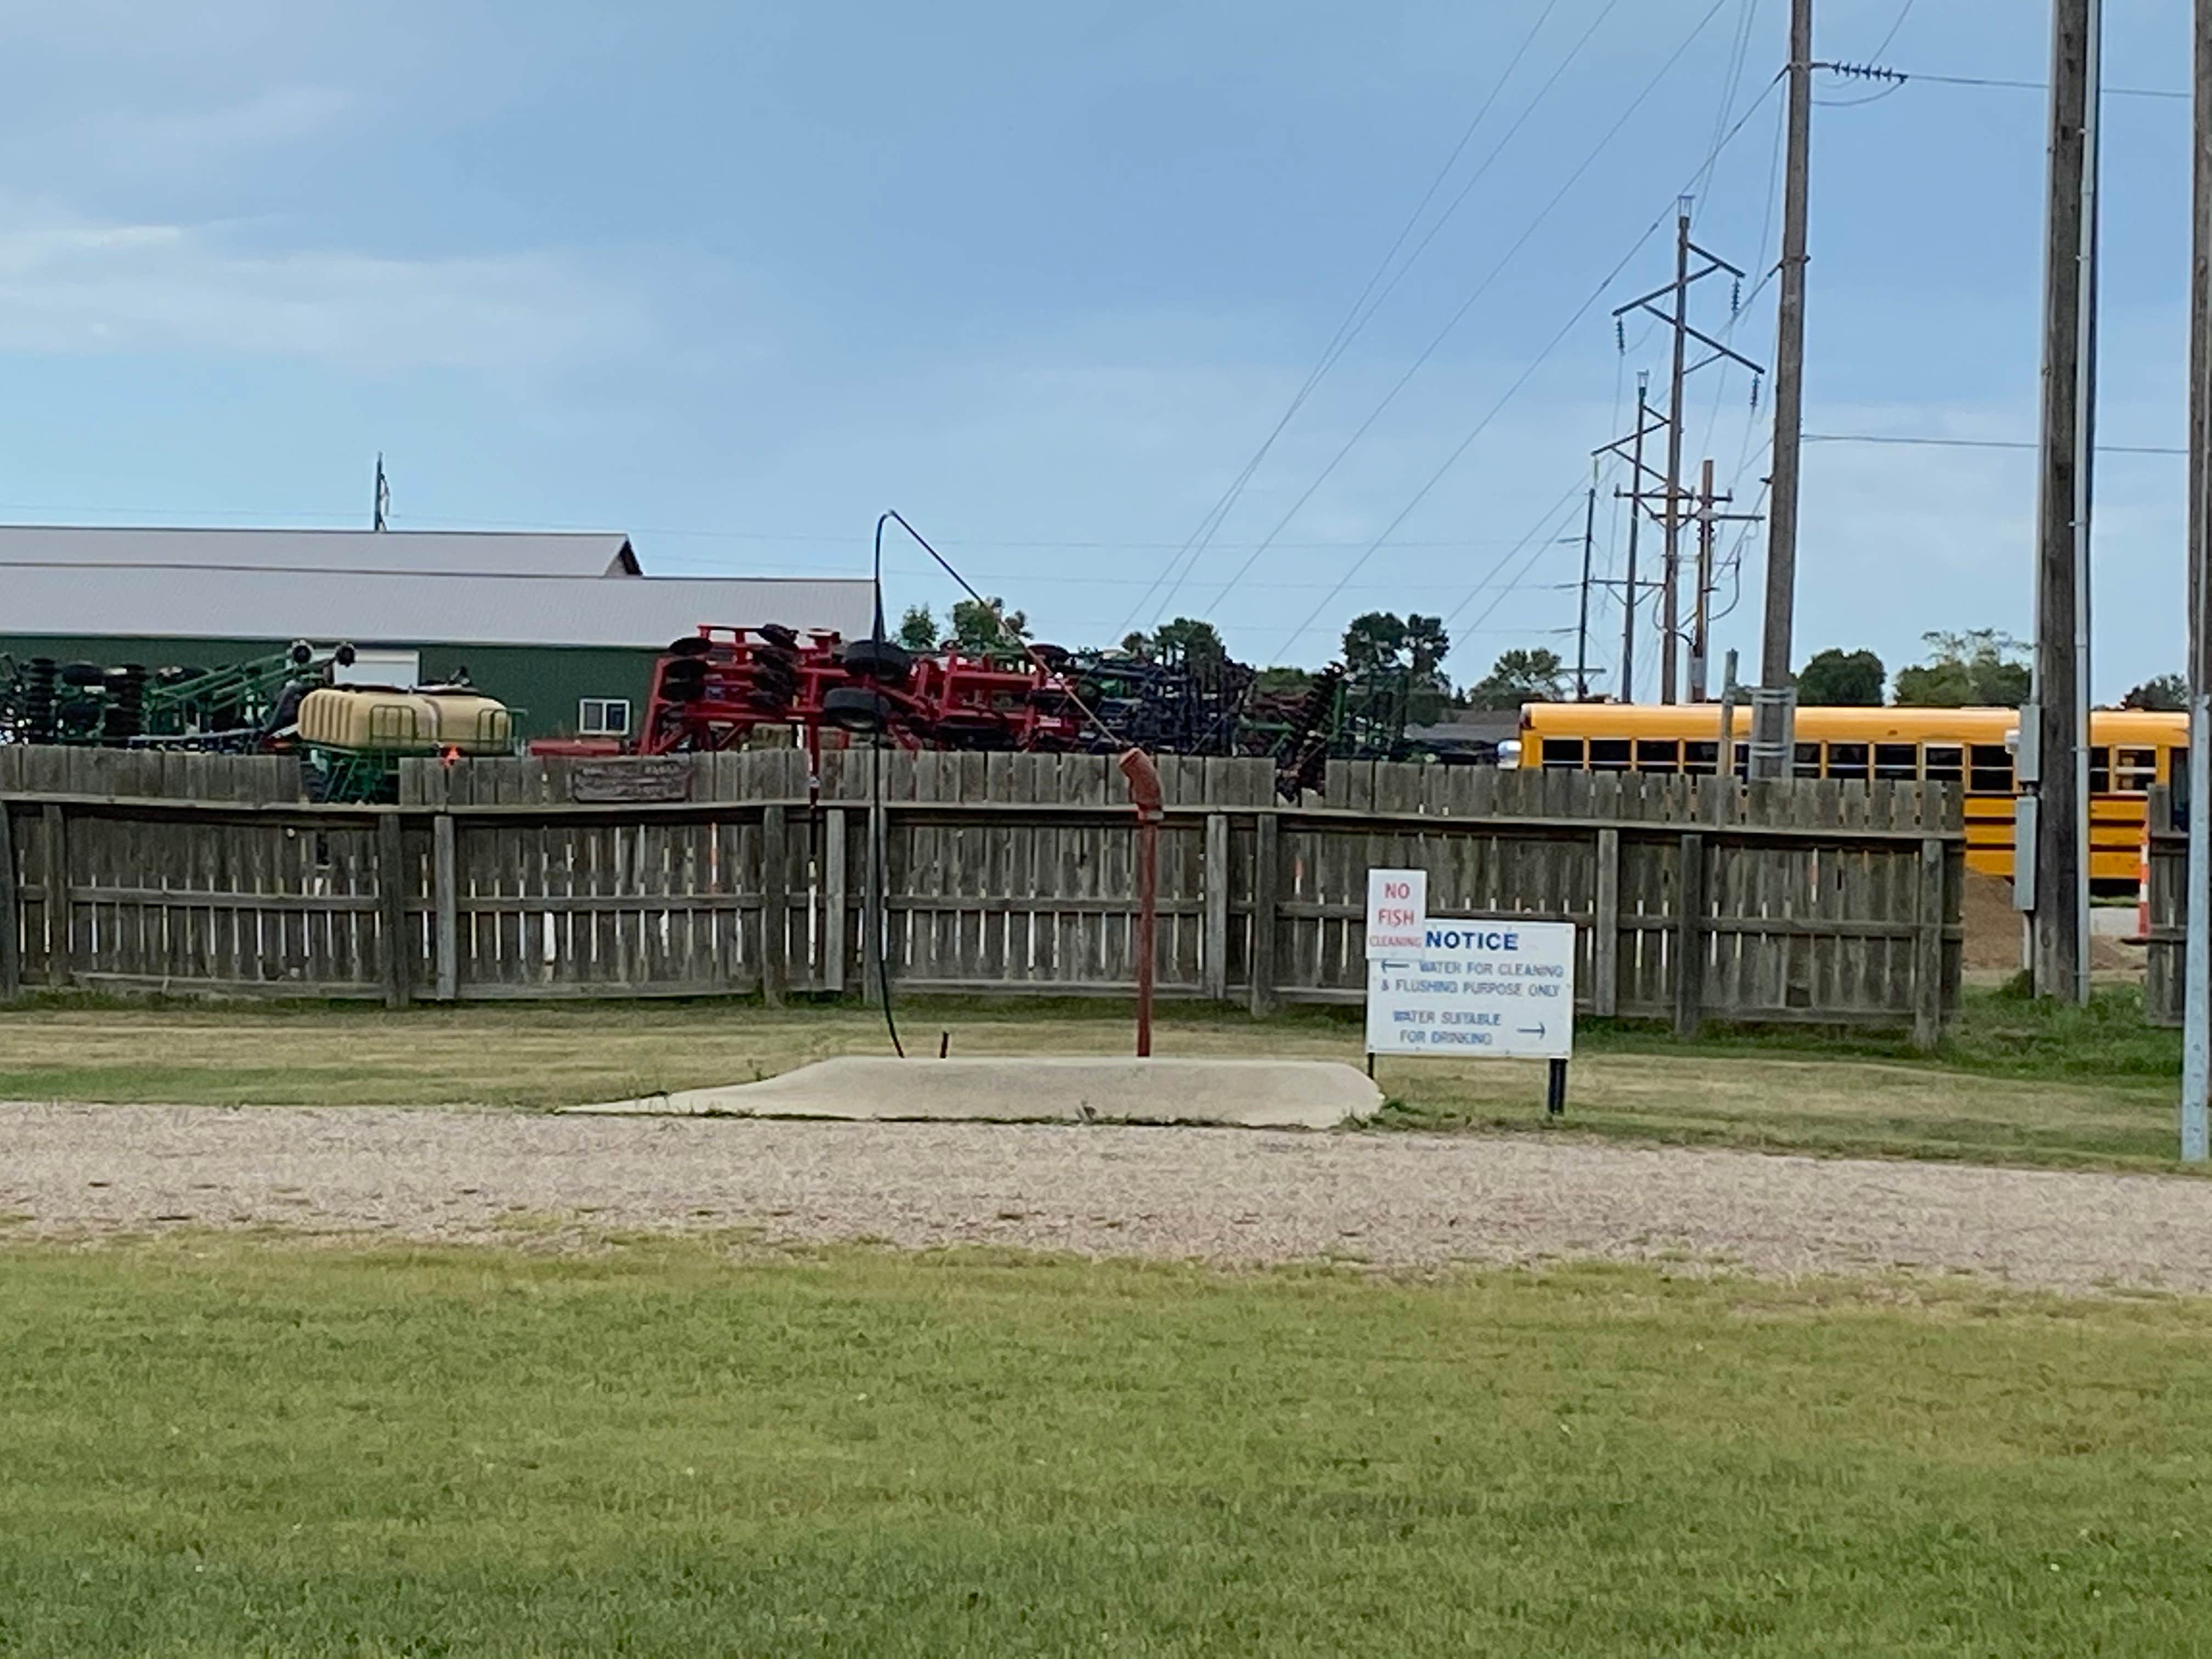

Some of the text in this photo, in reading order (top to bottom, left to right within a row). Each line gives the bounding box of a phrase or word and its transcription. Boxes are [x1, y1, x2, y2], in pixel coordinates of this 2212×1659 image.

[1384, 882, 1410, 899] NO
[1378, 910, 1414, 926] FISH
[1369, 936, 1421, 947] CLEANING
[1425, 931, 1519, 951] NOTICE
[1420, 961, 1564, 977] WATER FOR CLEANING
[1396, 980, 1459, 994] FLUSHING
[1464, 981, 1521, 996] PURPOSE
[1528, 984, 1561, 997] ONLY
[1393, 1011, 1501, 1026] WATER SUITABLE
[1400, 1030, 1492, 1045] FOR DRINKING
